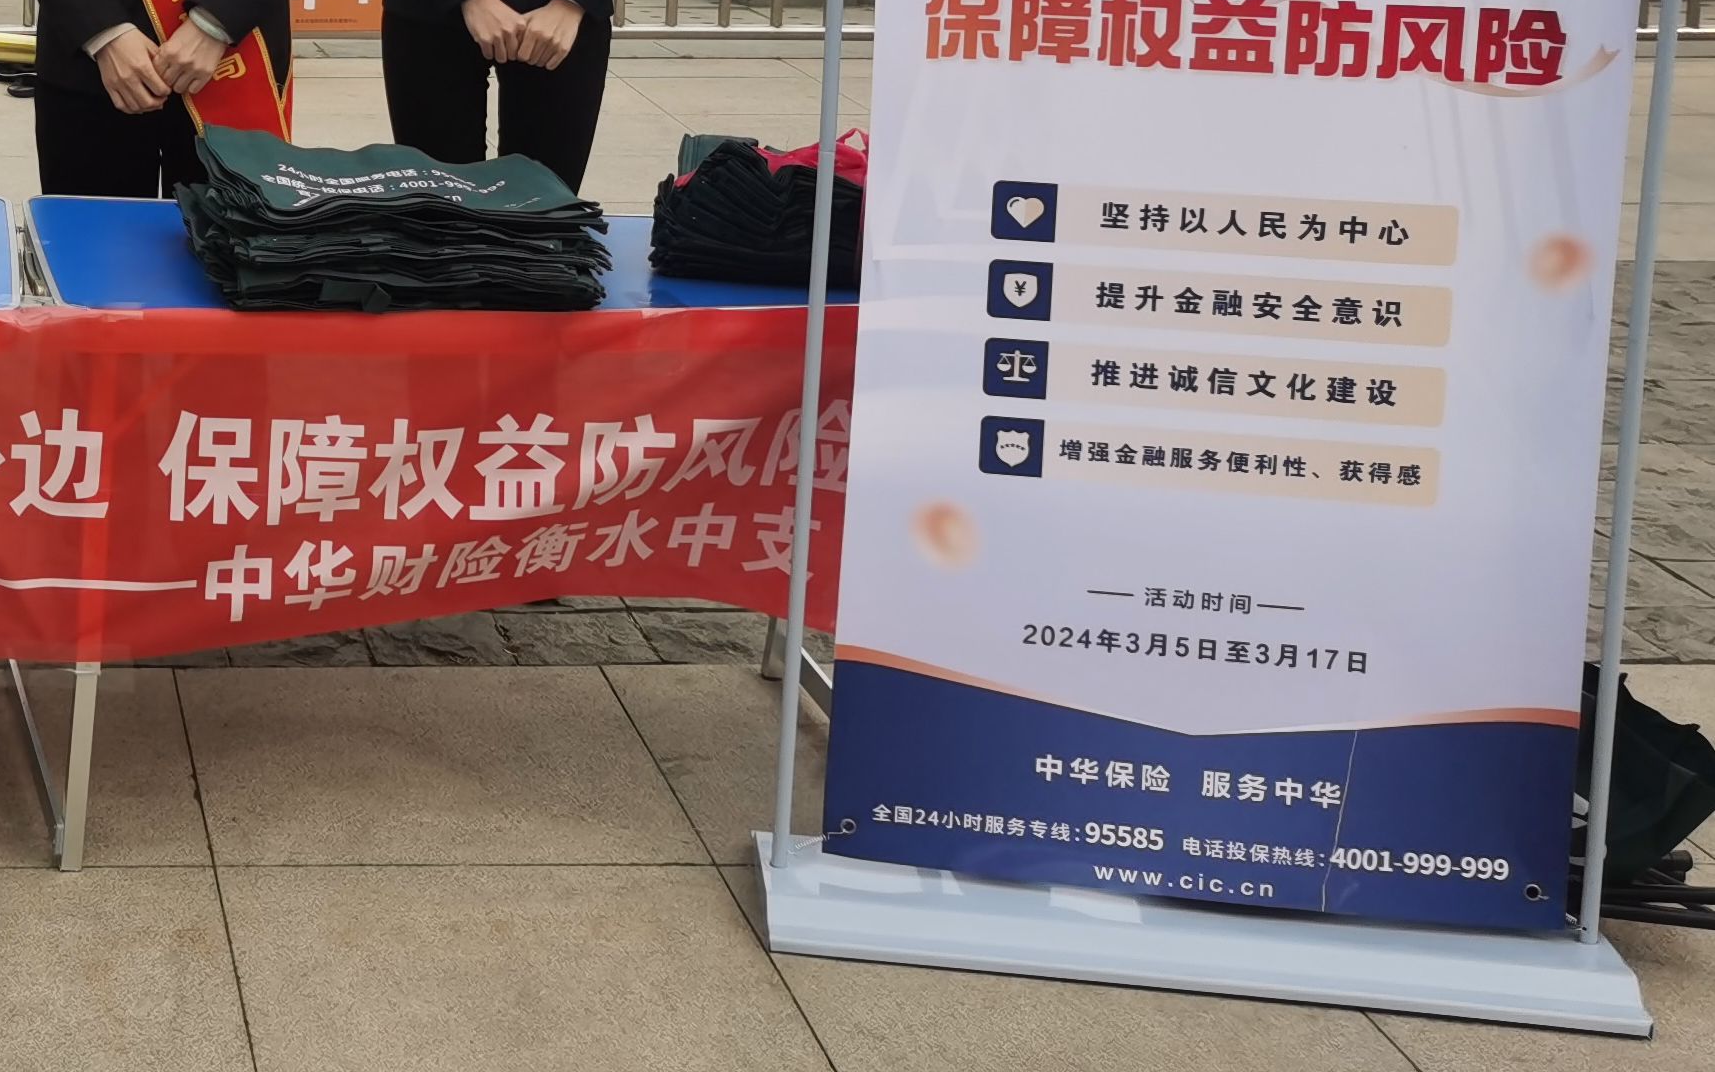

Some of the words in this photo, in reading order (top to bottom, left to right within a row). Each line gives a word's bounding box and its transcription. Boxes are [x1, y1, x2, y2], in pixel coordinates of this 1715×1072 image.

[1100, 201, 1409, 245] 坚持以人民为中心
[1095, 281, 1401, 327] 提升金融安全意识
[1091, 359, 1396, 406] 推进诚信文化建设
[158, 399, 852, 527] 保障权益防风险
[1059, 439, 1420, 485] 增强金融服务便利性、获得感
[1022, 624, 1366, 673] 2024年3月5日至3月17日
[1035, 754, 1170, 792] 中华保险
[1201, 770, 1340, 808] 服务中华
[1093, 865, 1272, 897] www.cic.cn
